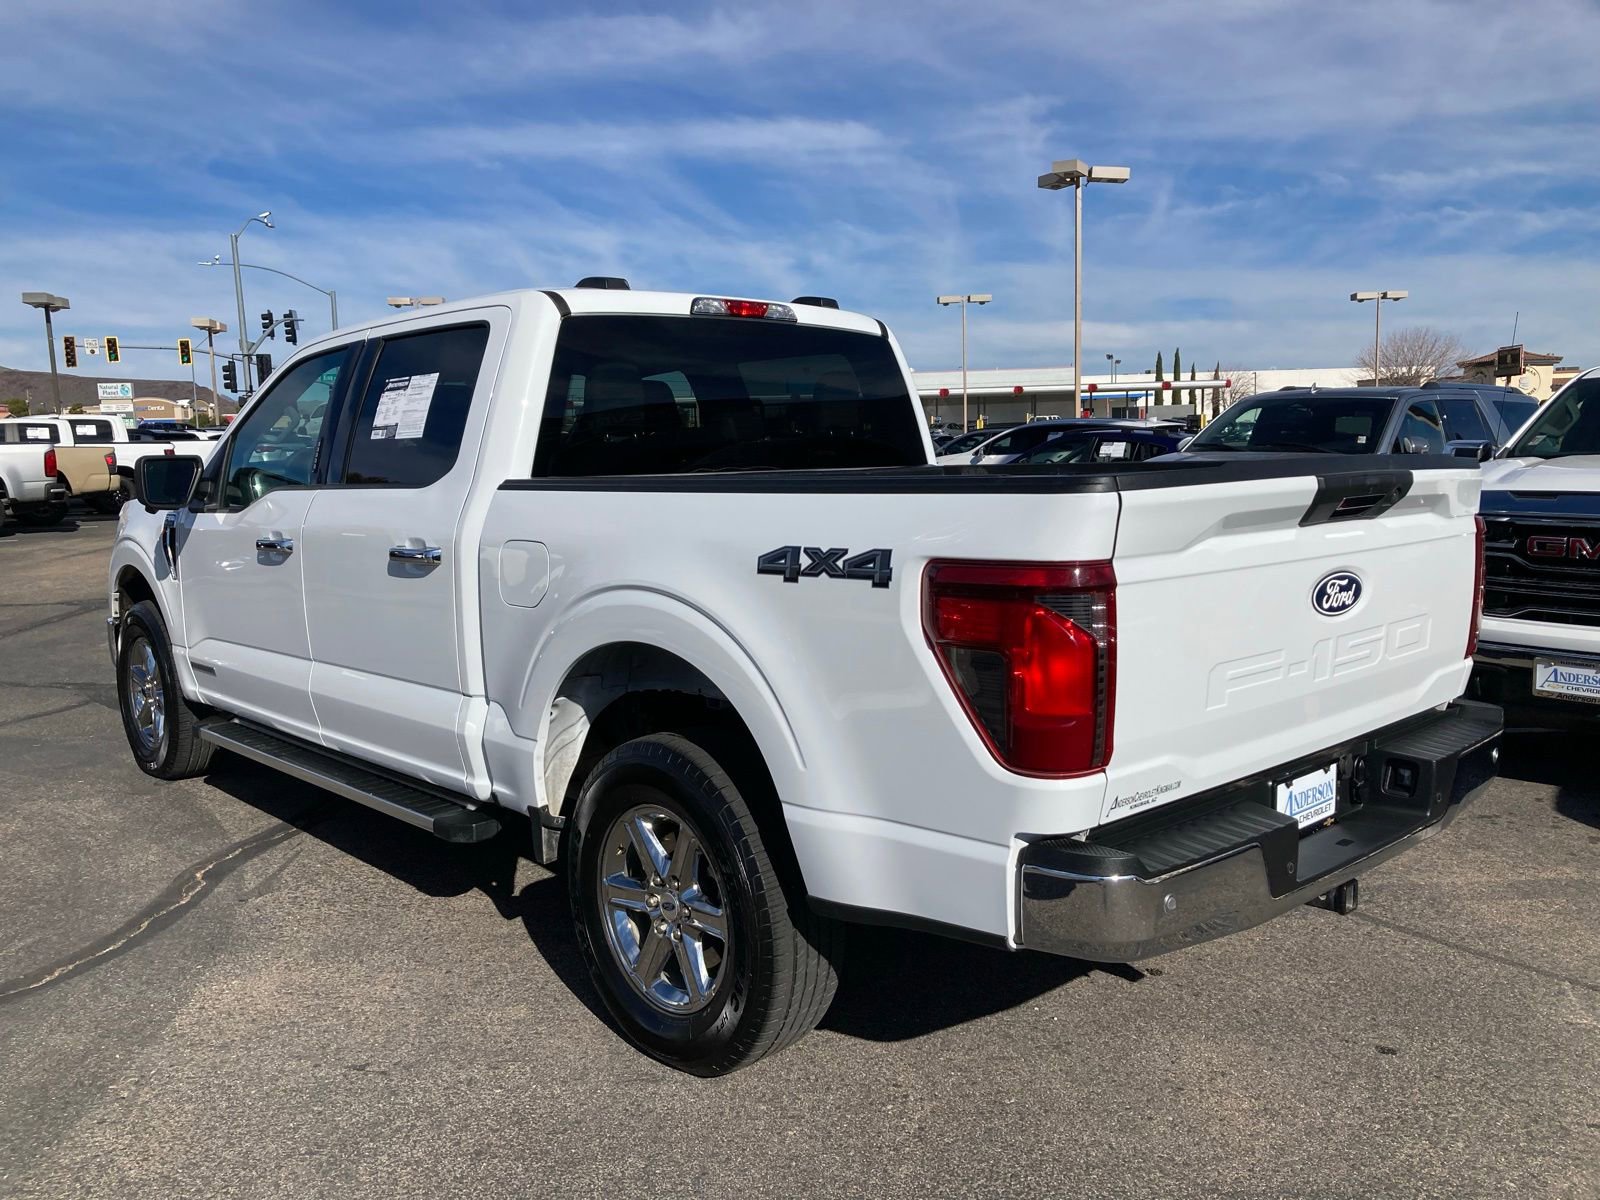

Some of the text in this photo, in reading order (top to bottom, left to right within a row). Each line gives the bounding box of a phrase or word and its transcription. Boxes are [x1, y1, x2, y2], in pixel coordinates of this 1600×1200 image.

[1322, 578, 1355, 610] Ford
[1205, 613, 1432, 711] F-150
[1539, 668, 1600, 688] ANDERS
[1284, 779, 1334, 816] ANDERSON
[1299, 802, 1332, 823] CHEVROLET
